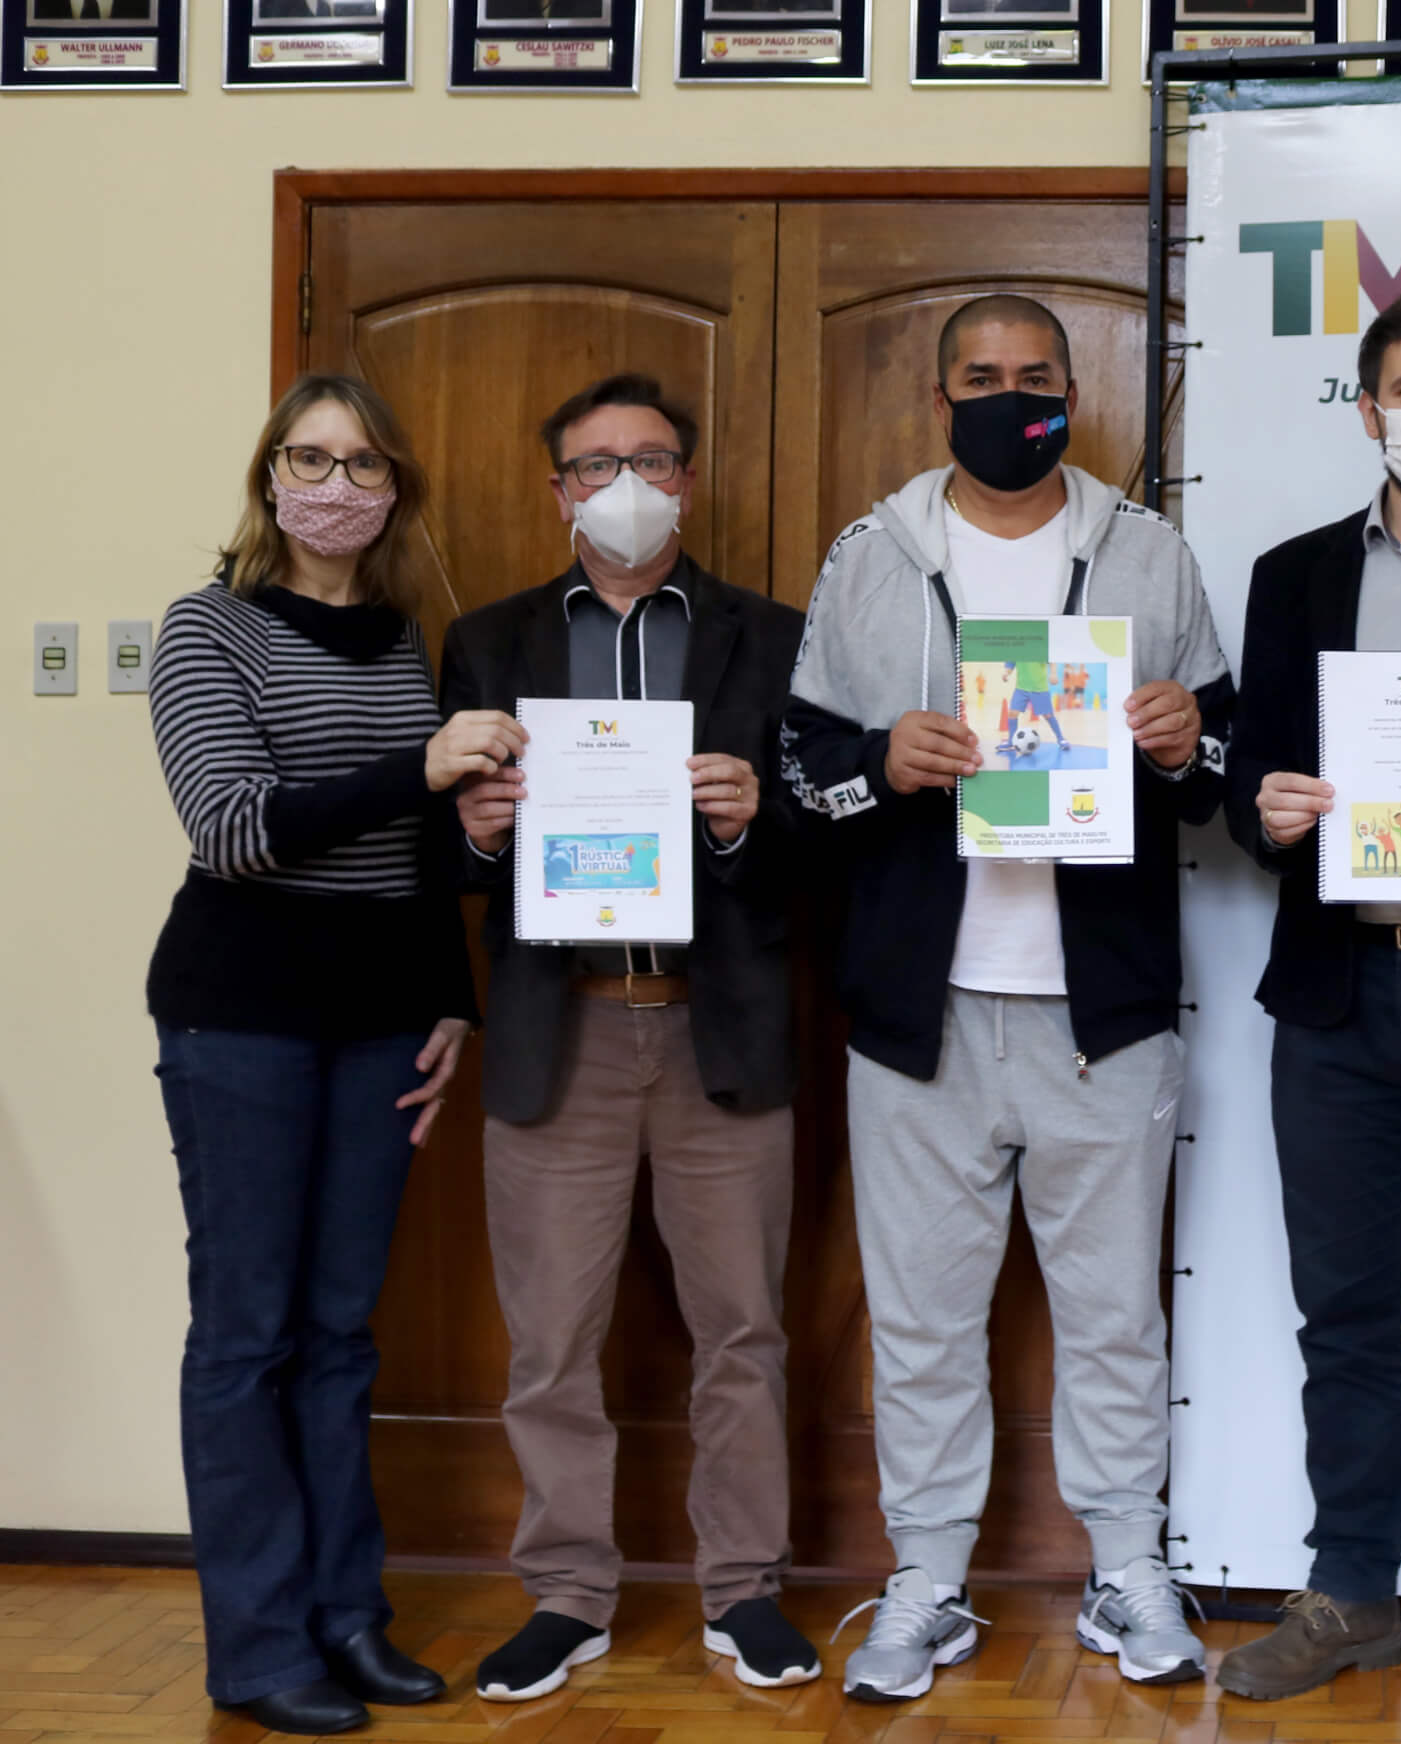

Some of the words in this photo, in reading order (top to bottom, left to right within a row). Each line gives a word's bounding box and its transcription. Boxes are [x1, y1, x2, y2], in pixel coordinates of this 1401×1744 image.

[732, 37, 762, 46] PEDRO
[765, 37, 795, 46] PAULO
[798, 36, 834, 45] FISCHER
[985, 40, 1005, 49] LUIZ
[60, 43, 96, 52] WALTER
[99, 42, 143, 52] ULLMANN
[588, 720, 618, 735] TM
[833, 787, 873, 810] FIL
[581, 861, 628, 871] VIRTUAL
